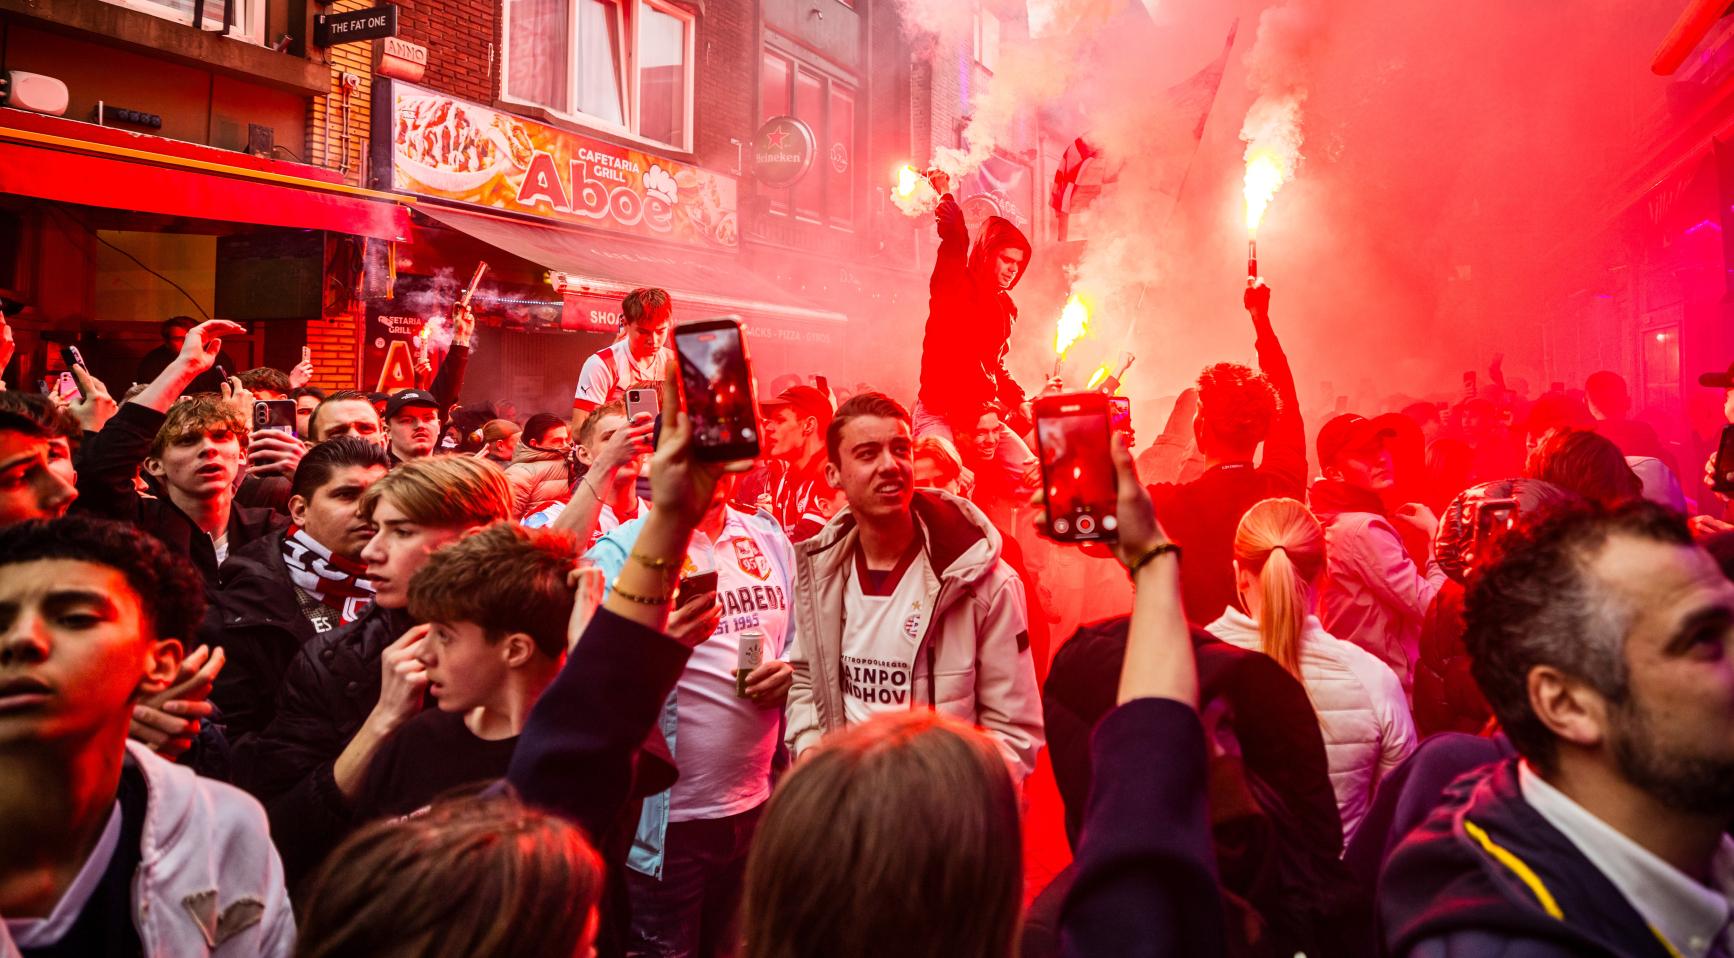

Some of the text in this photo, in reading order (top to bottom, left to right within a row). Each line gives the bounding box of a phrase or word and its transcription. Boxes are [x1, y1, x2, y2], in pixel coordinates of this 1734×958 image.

[331, 15, 386, 34] THE FAT ONE
[388, 40, 424, 61] ANNO
[578, 148, 640, 174] CAFETARIA
[593, 165, 626, 183] GRILL
[516, 150, 673, 232] Aboe
[378, 315, 422, 326] FETARIA
[389, 326, 412, 335] GRILL
[747, 327, 772, 338] ACKS
[778, 329, 801, 341] PIZZA
[713, 620, 728, 635] ST
[845, 665, 911, 686] AINPO
[845, 680, 906, 704] NDHOV
